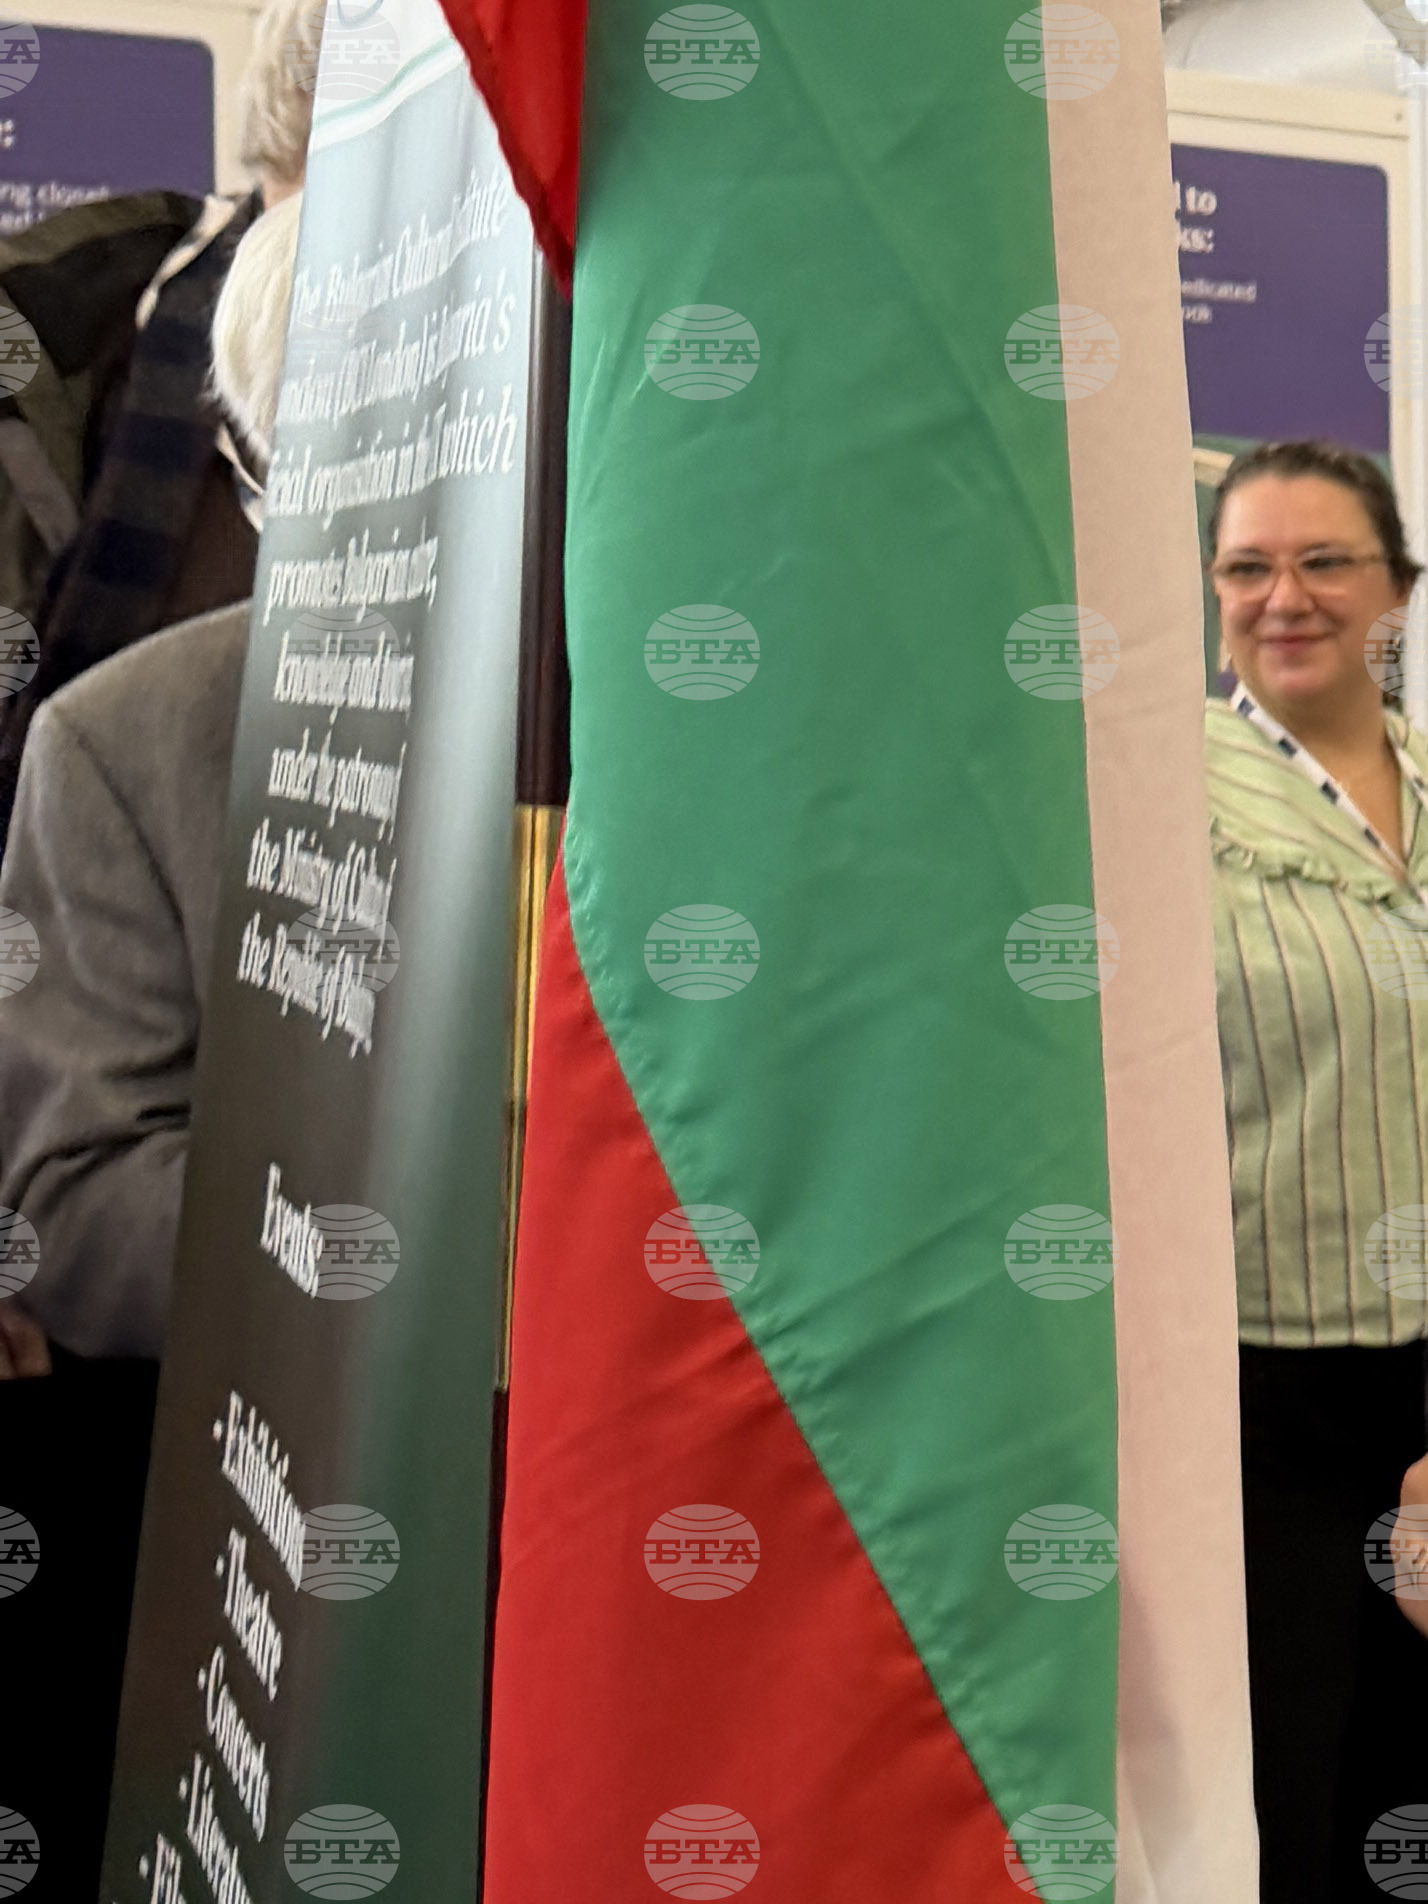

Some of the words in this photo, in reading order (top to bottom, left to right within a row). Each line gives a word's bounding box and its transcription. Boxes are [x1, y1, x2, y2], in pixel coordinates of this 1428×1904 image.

[444, 384, 519, 474] which
[247, 816, 280, 890] the
[238, 912, 270, 986] the
[222, 1390, 307, 1593] Exhibitions
[223, 1527, 283, 1702] Theatre
[203, 1644, 271, 1843] Concerts
